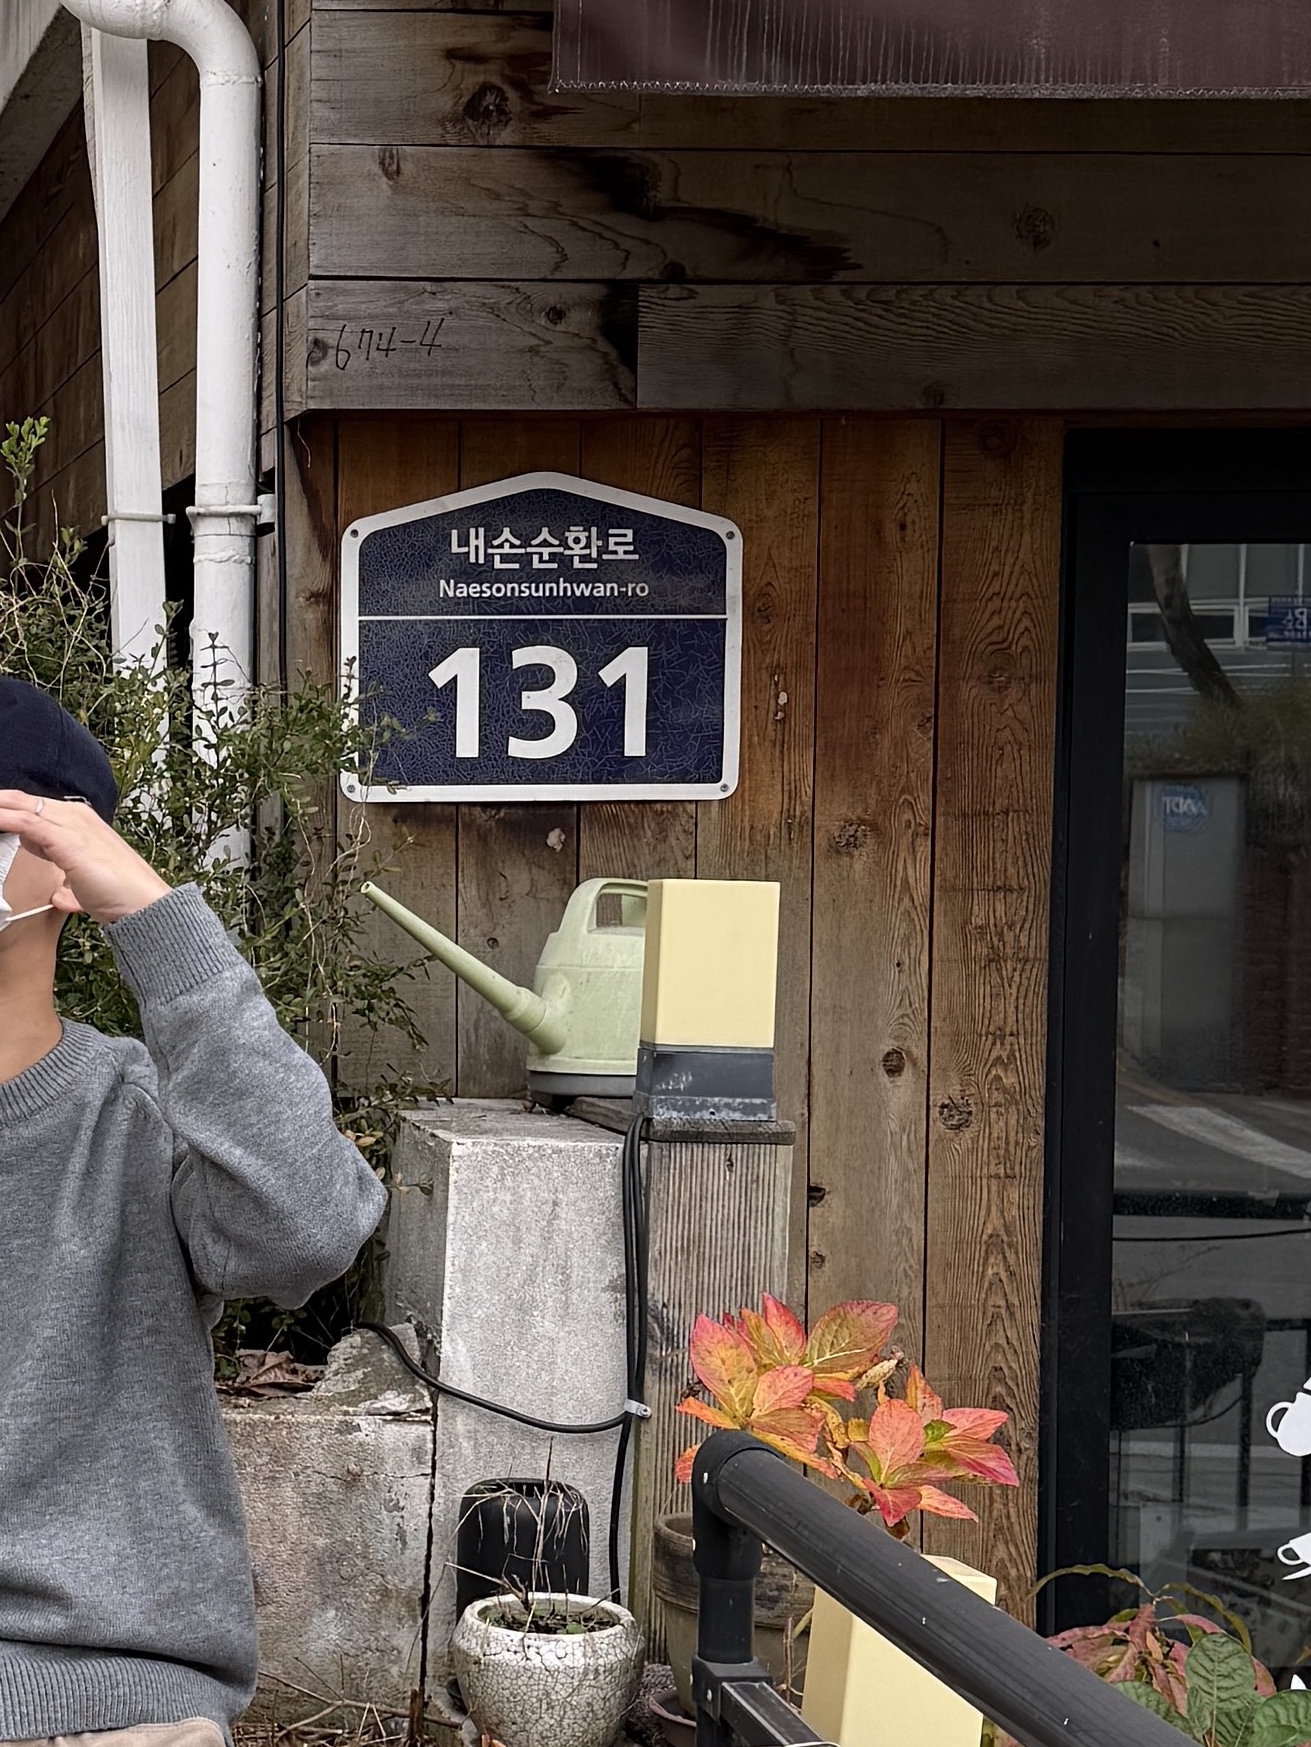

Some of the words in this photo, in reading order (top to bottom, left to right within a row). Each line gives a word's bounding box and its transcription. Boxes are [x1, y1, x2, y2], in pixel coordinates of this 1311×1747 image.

[335, 318, 445, 371] 674-4
[450, 526, 640, 570] 내손순환로
[439, 577, 650, 598] Naesonsunhwan-ro
[427, 644, 649, 759] 131
